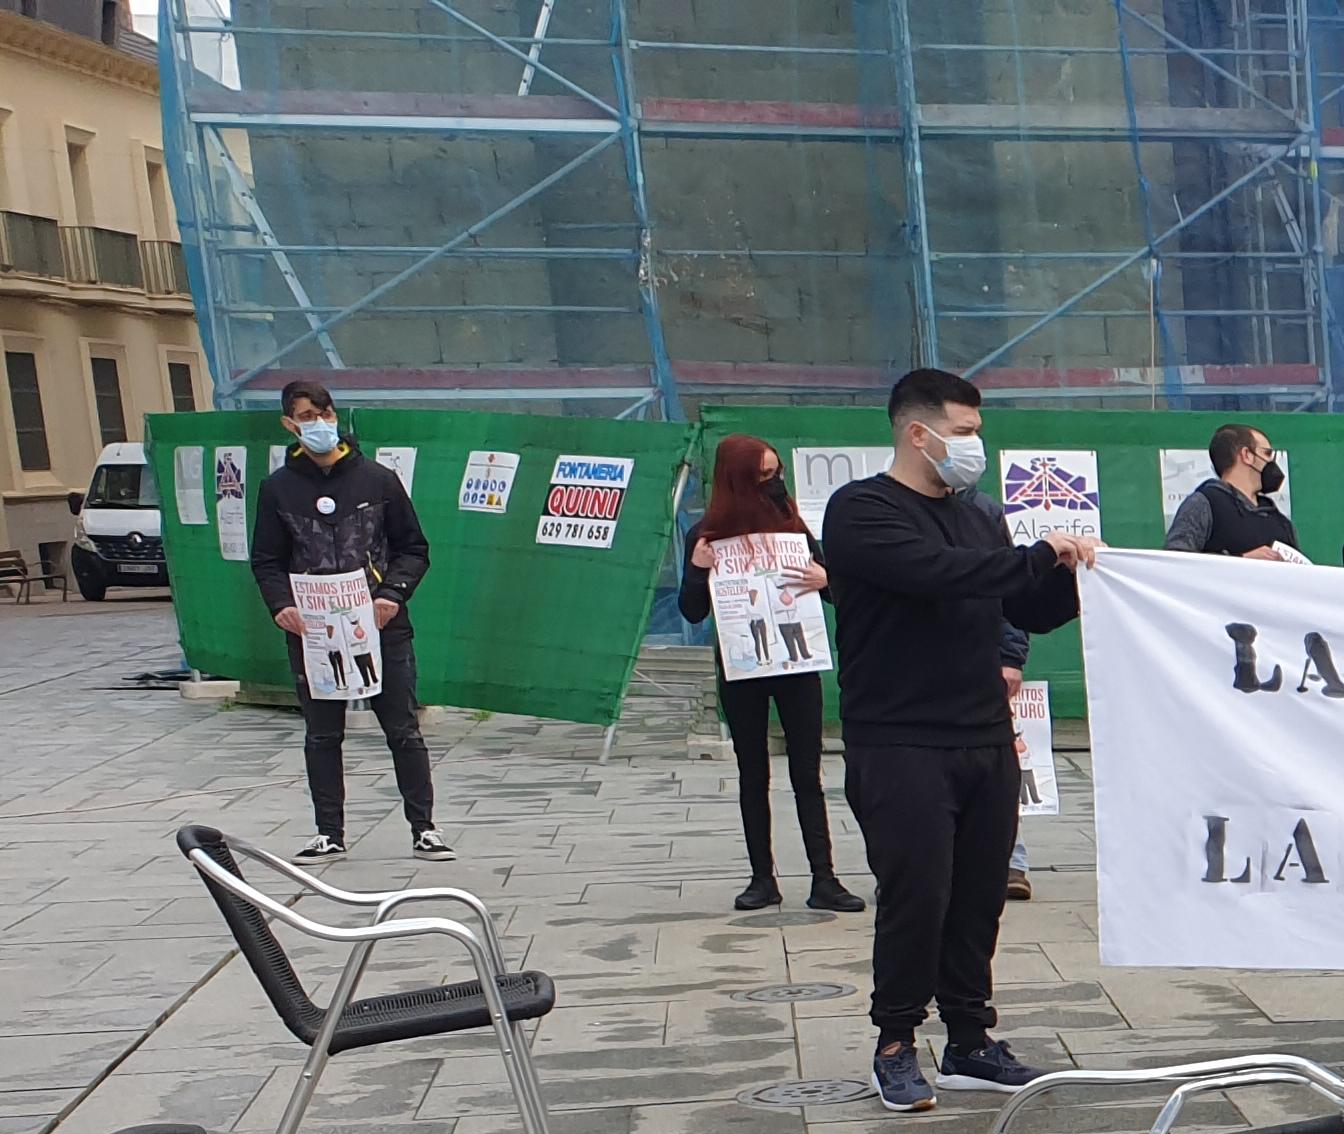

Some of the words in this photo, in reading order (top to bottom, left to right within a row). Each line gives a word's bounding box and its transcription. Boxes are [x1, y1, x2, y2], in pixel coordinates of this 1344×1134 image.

[549, 485, 621, 518] QUINI
[541, 521, 562, 538] 629
[565, 523, 583, 539] 781
[587, 525, 610, 541] 658
[724, 556, 751, 575] SIN
[294, 580, 338, 595] ESTAMOS
[296, 595, 304, 609] Y
[307, 595, 326, 611] SIN
[1201, 814, 1330, 884] LA
